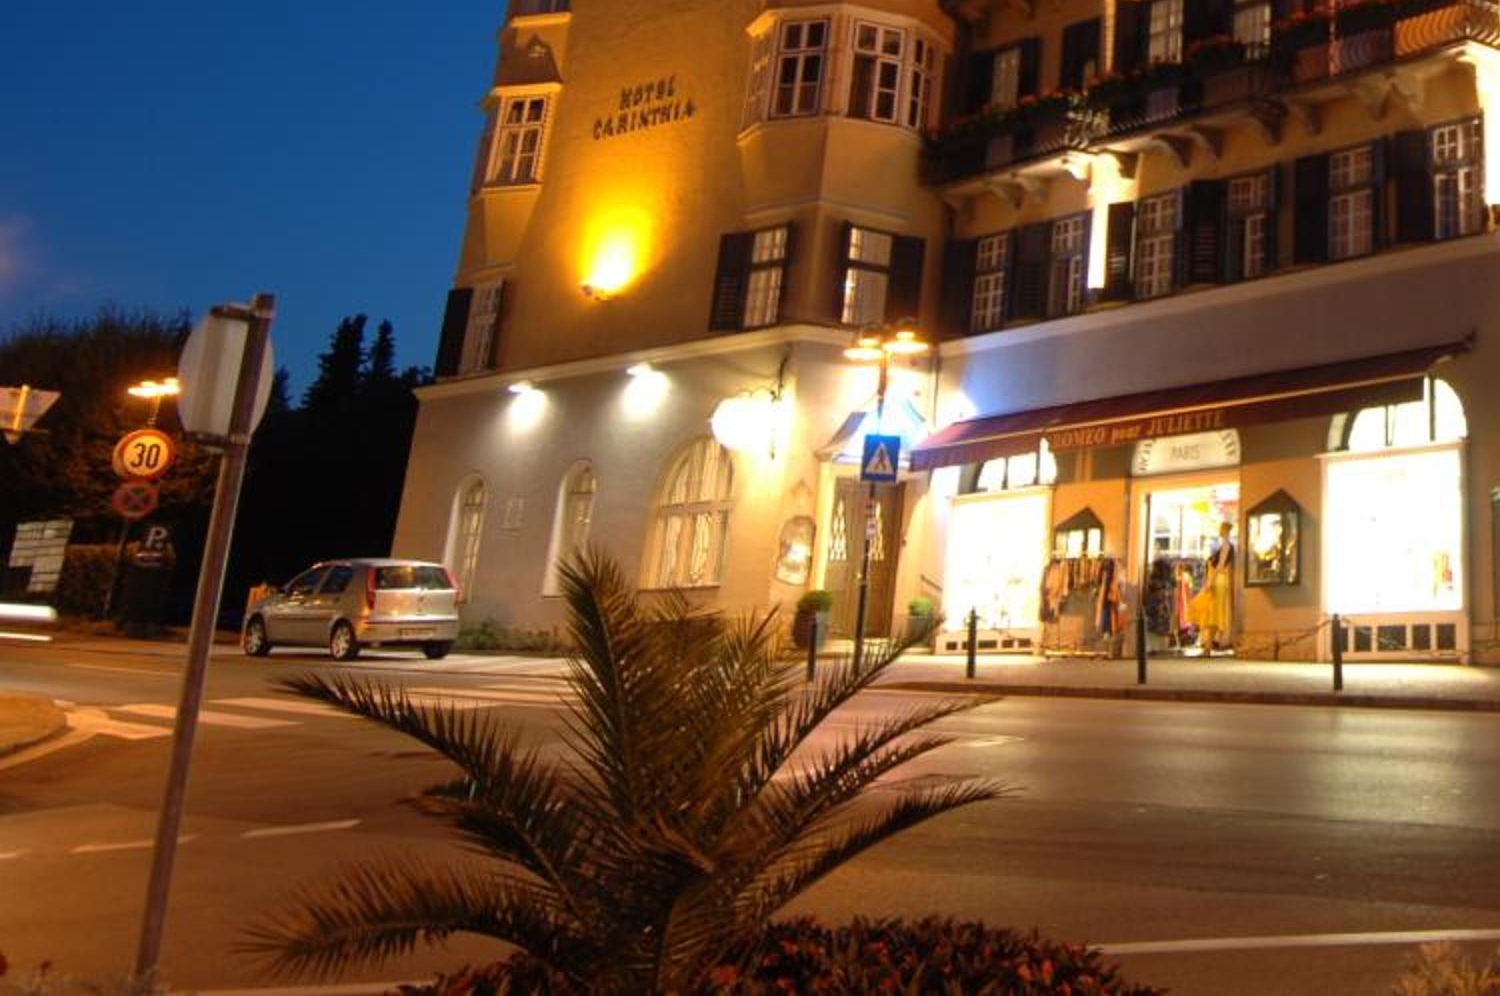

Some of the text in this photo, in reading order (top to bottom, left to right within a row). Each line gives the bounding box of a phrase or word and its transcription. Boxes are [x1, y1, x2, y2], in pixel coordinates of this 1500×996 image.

[620, 75, 676, 110] HOTEL
[593, 97, 697, 140] CARINTHIA
[1052, 427, 1105, 446] ROMEO
[1150, 412, 1224, 434] JULIETTE
[130, 442, 161, 469] 30
